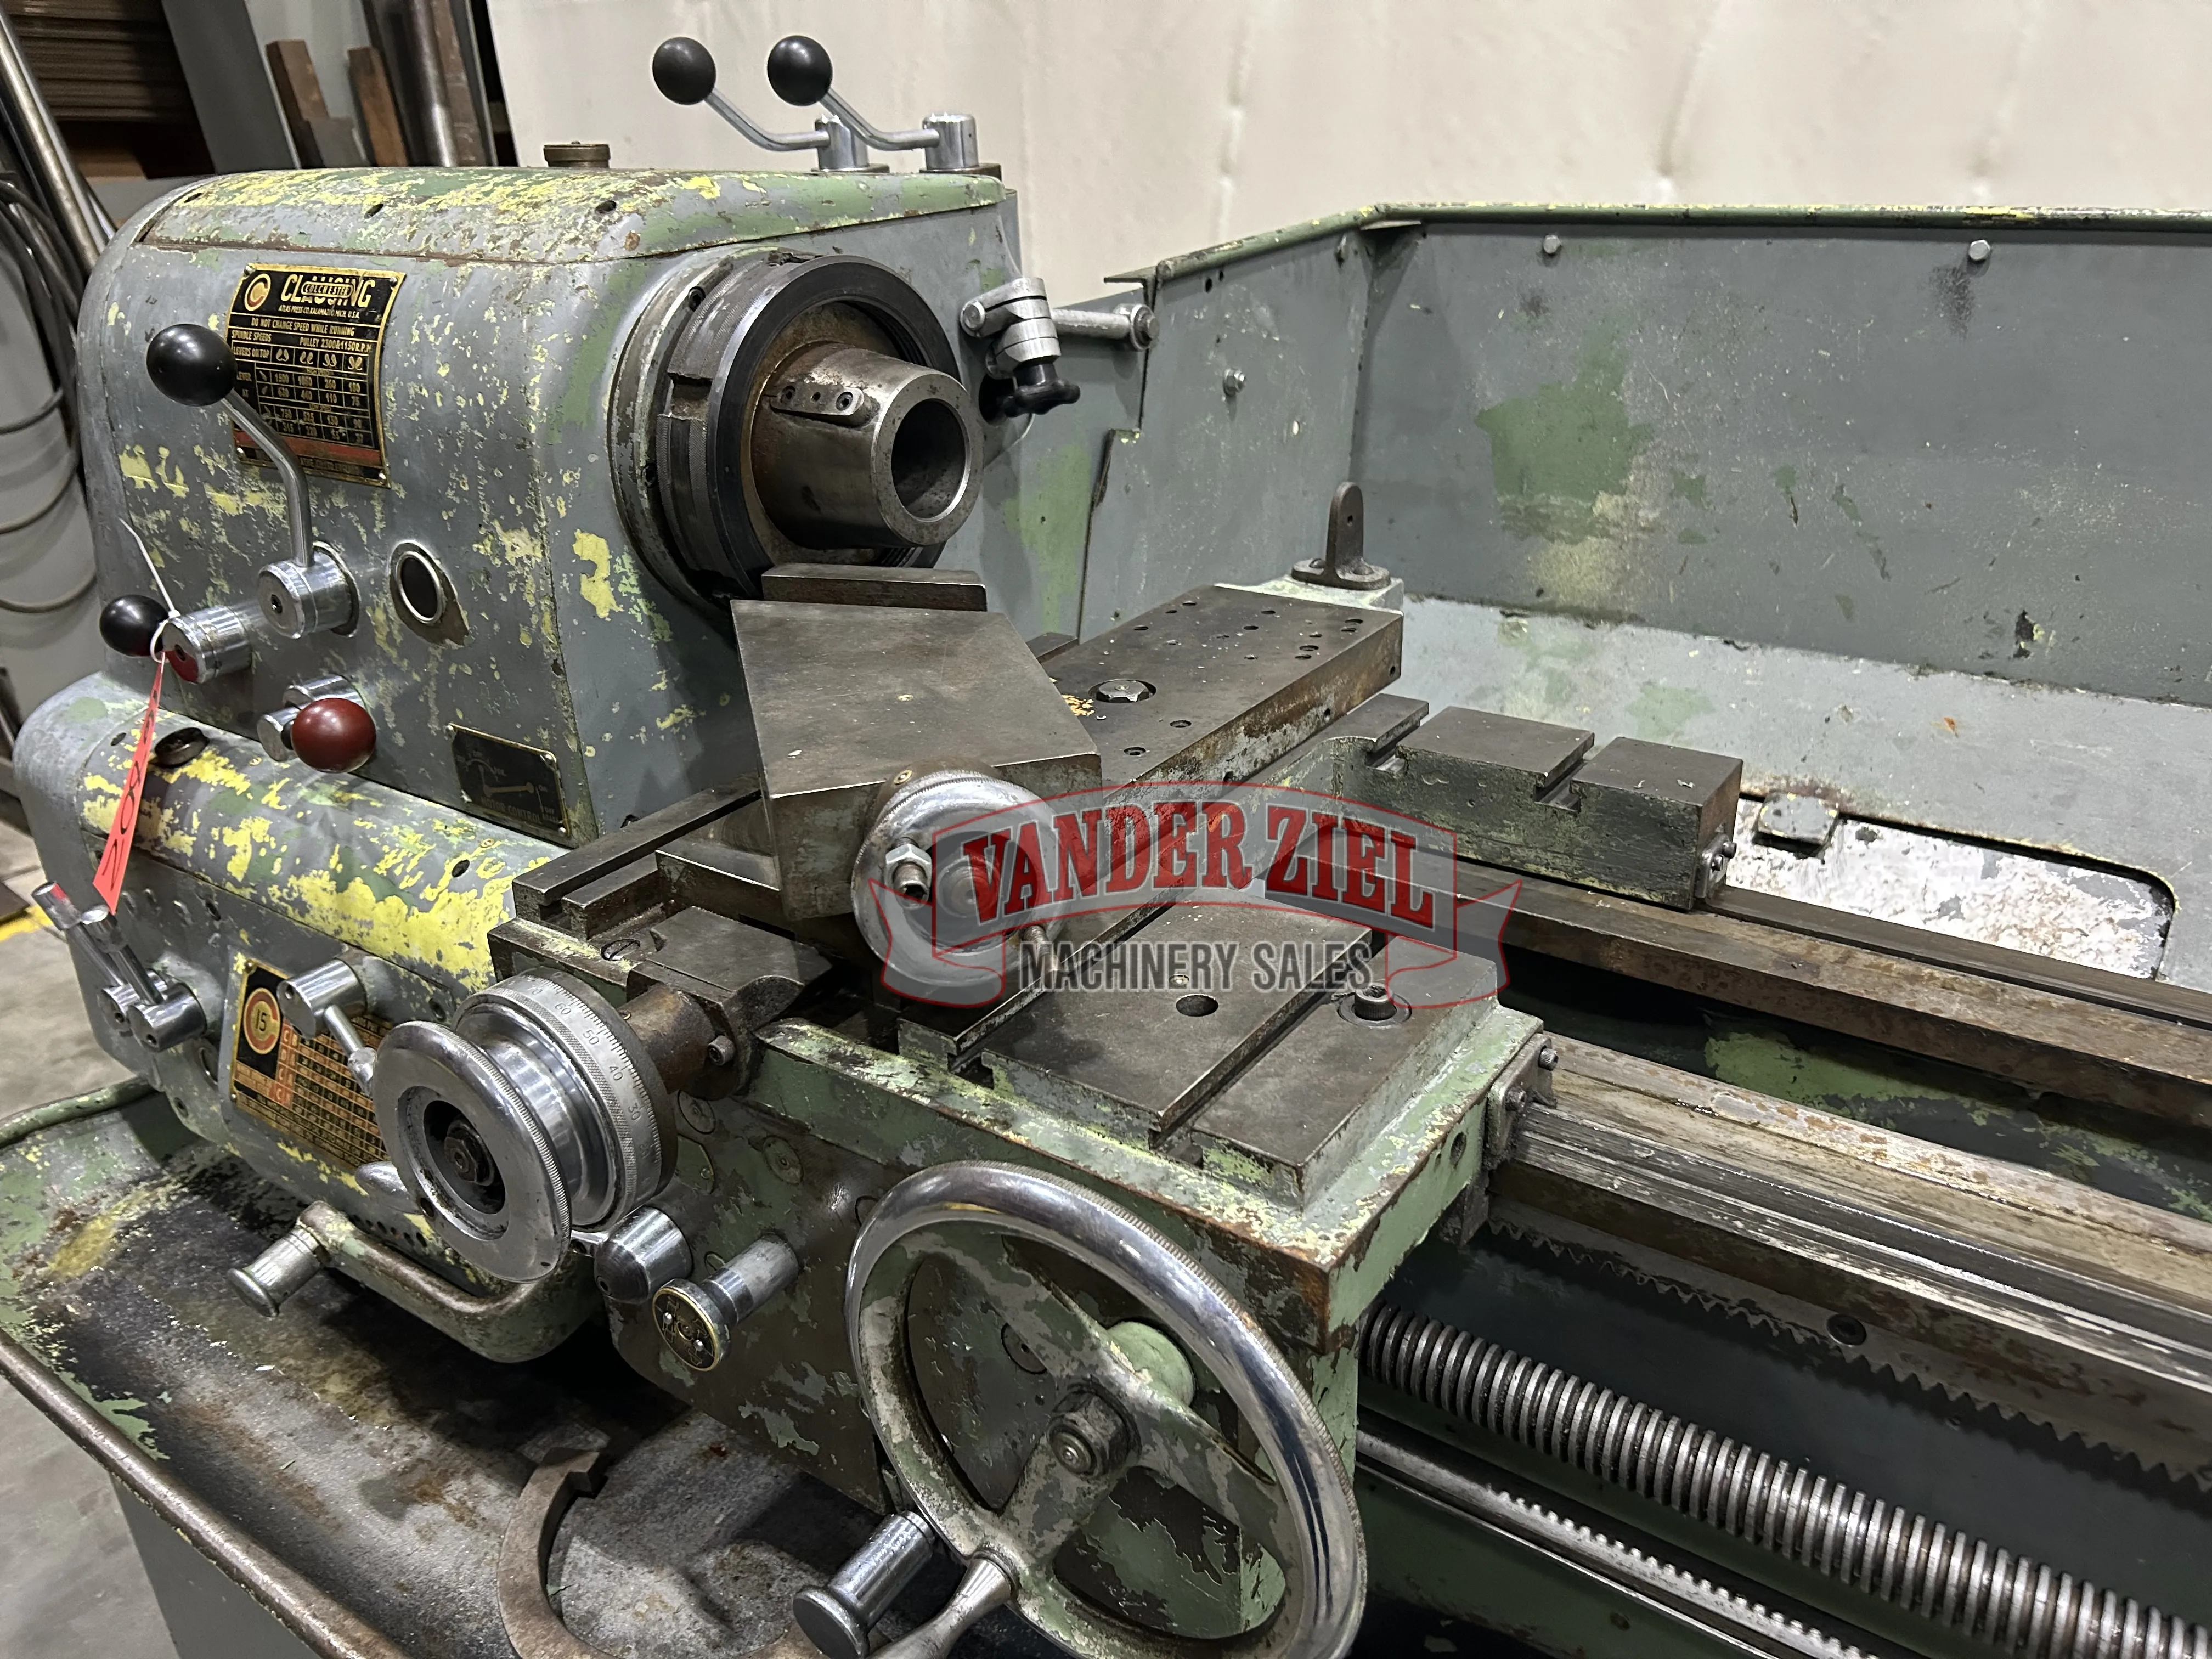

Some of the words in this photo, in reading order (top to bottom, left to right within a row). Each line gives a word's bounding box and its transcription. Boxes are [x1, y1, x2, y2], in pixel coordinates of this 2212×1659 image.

[304, 284, 350, 296] COLCHESTER
[251, 317, 258, 326] DO
[261, 318, 270, 328] NOT
[272, 319, 293, 329] CHANGE
[293, 321, 309, 331] SPEED
[311, 323, 328, 334] WHILE
[329, 324, 355, 336] RUNNING
[232, 330, 252, 340] SPINDLE
[253, 332, 272, 342] SPEEDS
[300, 337, 319, 348] PULLEY
[233, 346, 251, 357] LEVERS
[252, 348, 258, 357] ON
[258, 349, 270, 358] TOP
[507, 805, 540, 823] CONTROL
[555, 1003, 572, 1015] 60
[255, 1009, 267, 1031] 15
[583, 1029, 599, 1045] 50
[608, 1066, 623, 1081] 40
[628, 1102, 641, 1121] 30
